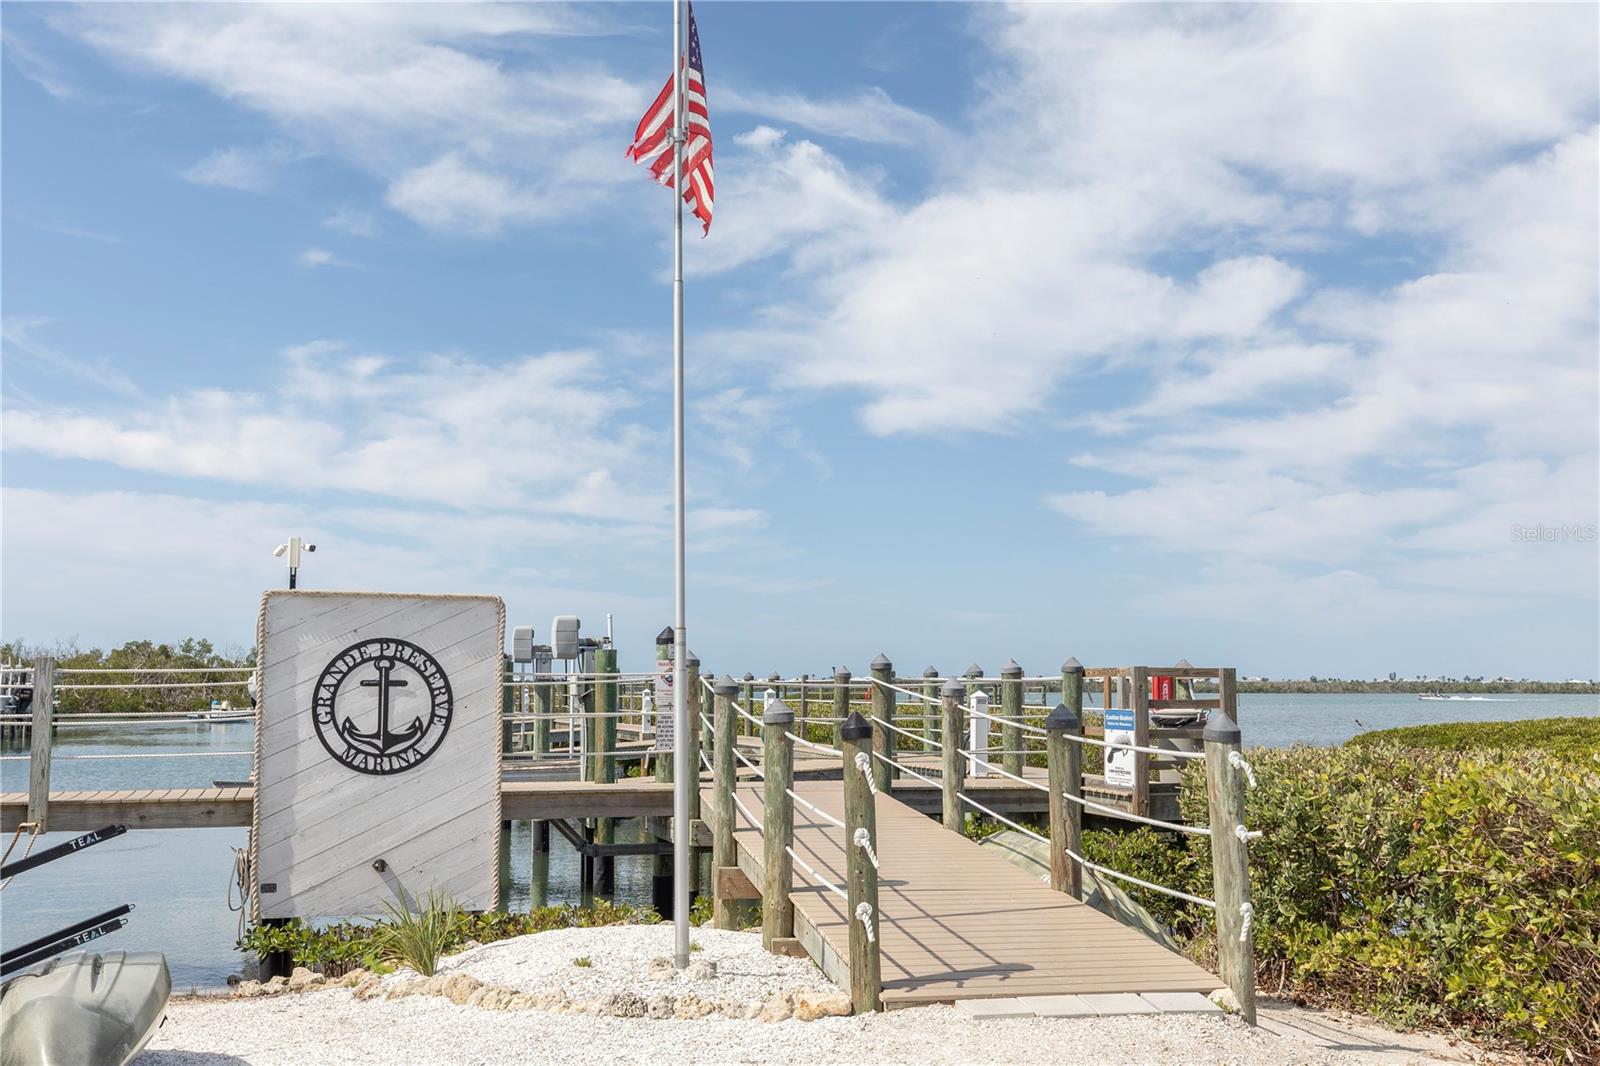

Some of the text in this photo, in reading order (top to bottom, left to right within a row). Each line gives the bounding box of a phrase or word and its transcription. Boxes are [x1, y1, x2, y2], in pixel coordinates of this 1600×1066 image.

[316, 642, 449, 727] GRANDE PRESERVE
[341, 747, 425, 771] MARINA
[69, 832, 102, 849] TEAL
[74, 927, 106, 944] TEAL
